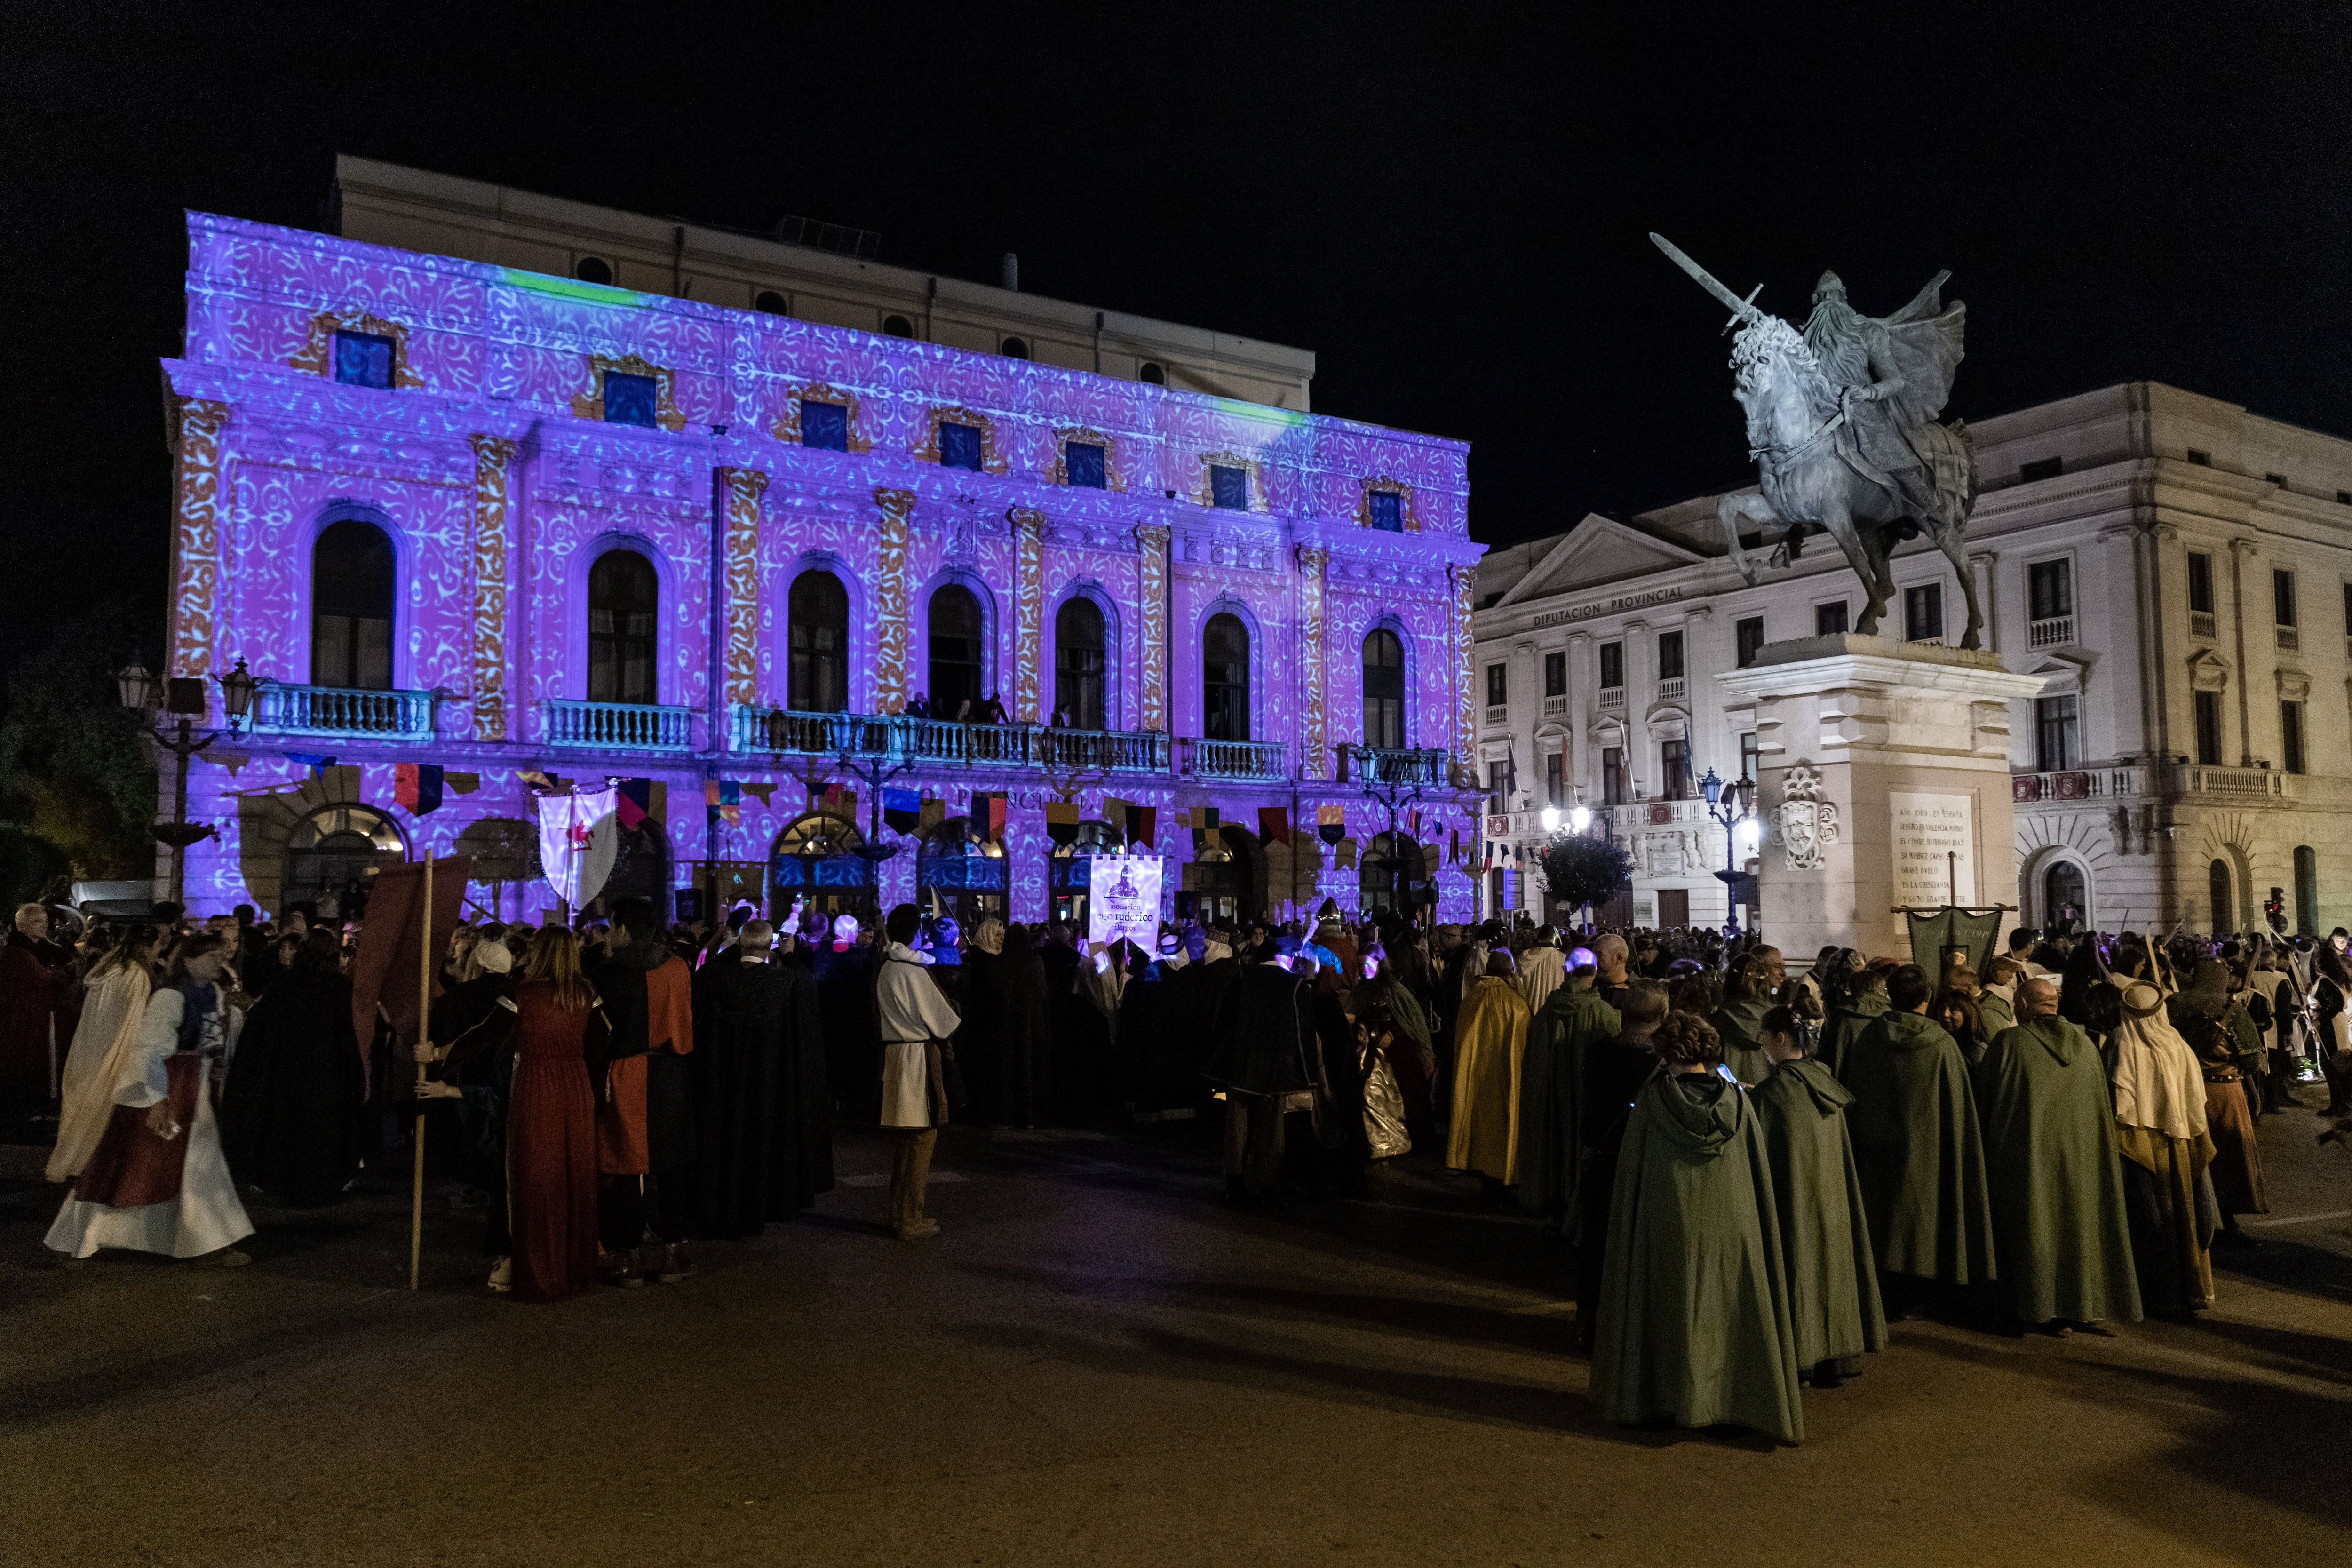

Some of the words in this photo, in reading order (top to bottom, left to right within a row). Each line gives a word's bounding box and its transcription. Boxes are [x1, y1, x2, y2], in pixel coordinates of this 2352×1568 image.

[1534, 604, 1600, 626] DIPUTACION
[1611, 587, 1683, 611] PROVINCIAL
[1097, 913, 1113, 923] ego
[1115, 911, 1153, 922] ruderico
[1114, 923, 1136, 933] Burgos
